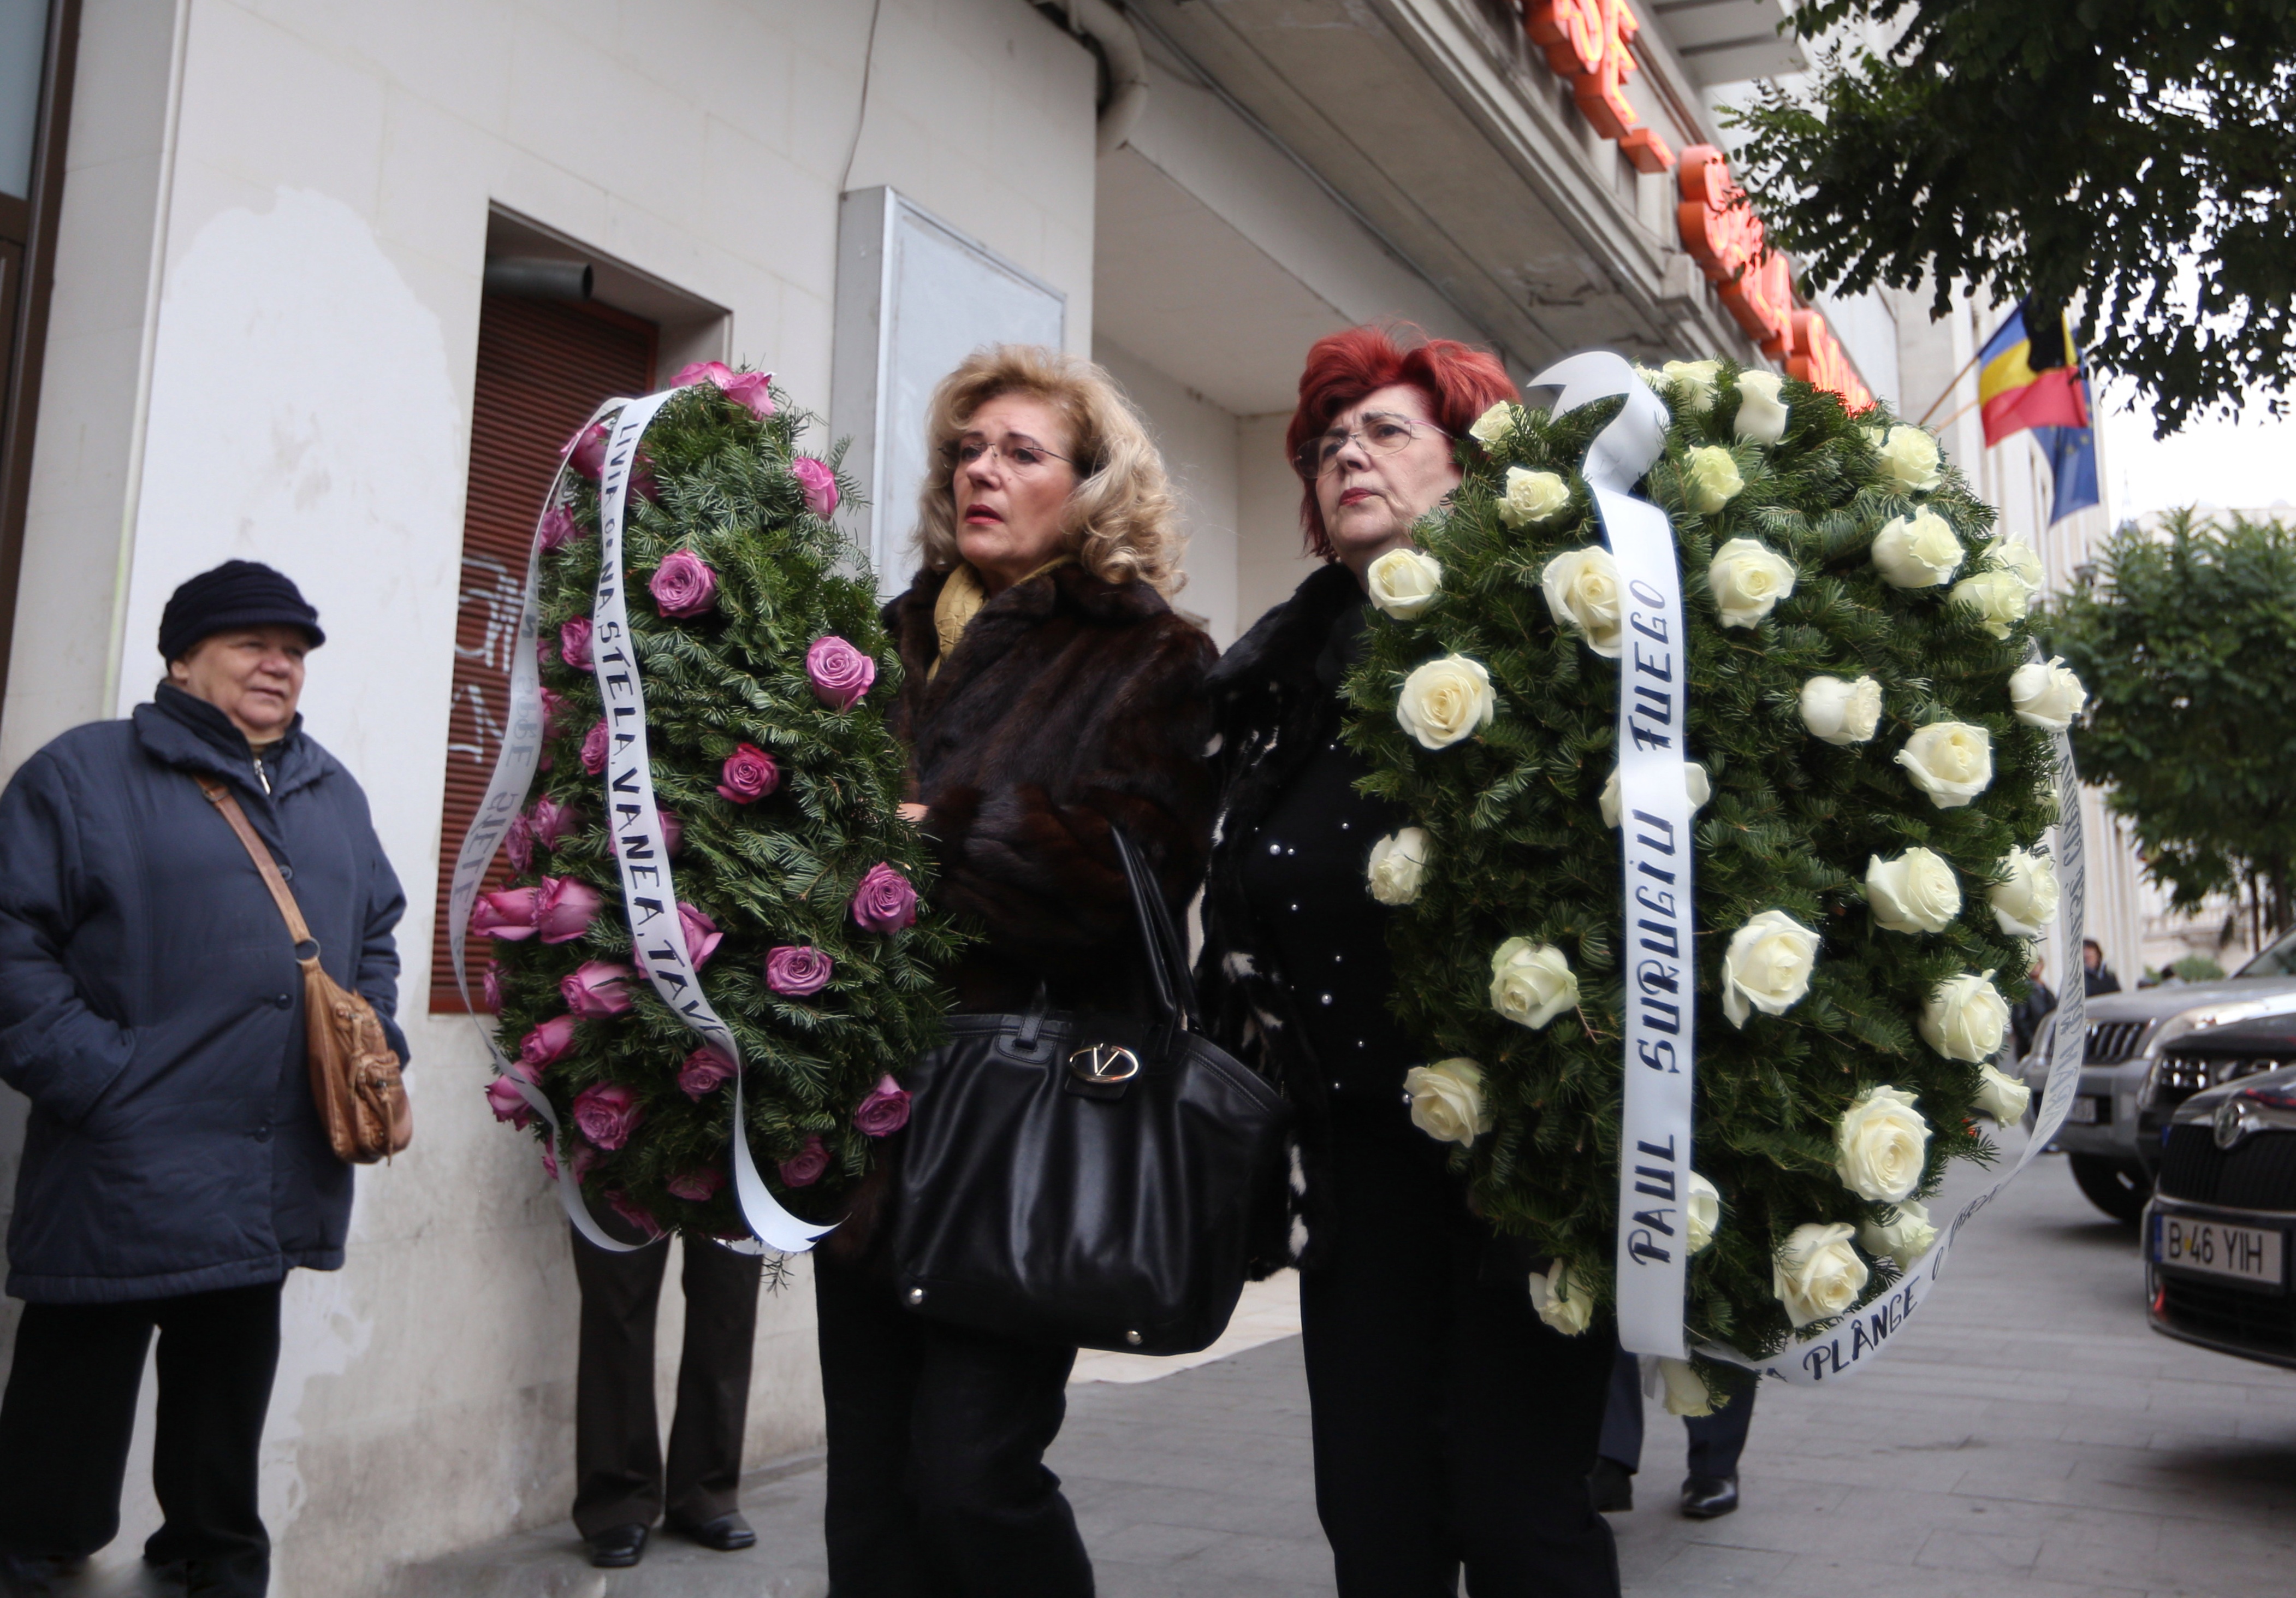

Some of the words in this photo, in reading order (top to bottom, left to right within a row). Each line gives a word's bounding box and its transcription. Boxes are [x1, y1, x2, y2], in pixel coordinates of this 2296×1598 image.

[1628, 579, 1672, 751] FUEGO
[1629, 808, 1681, 1074] SURUGIU
[1627, 1134, 1677, 1265] PAUL
[2169, 1222, 2181, 1258] B
[2191, 1226, 2214, 1265] 46
[2223, 1230, 2263, 1275] YIH
[1802, 1276, 1920, 1381] PLÂNGE
